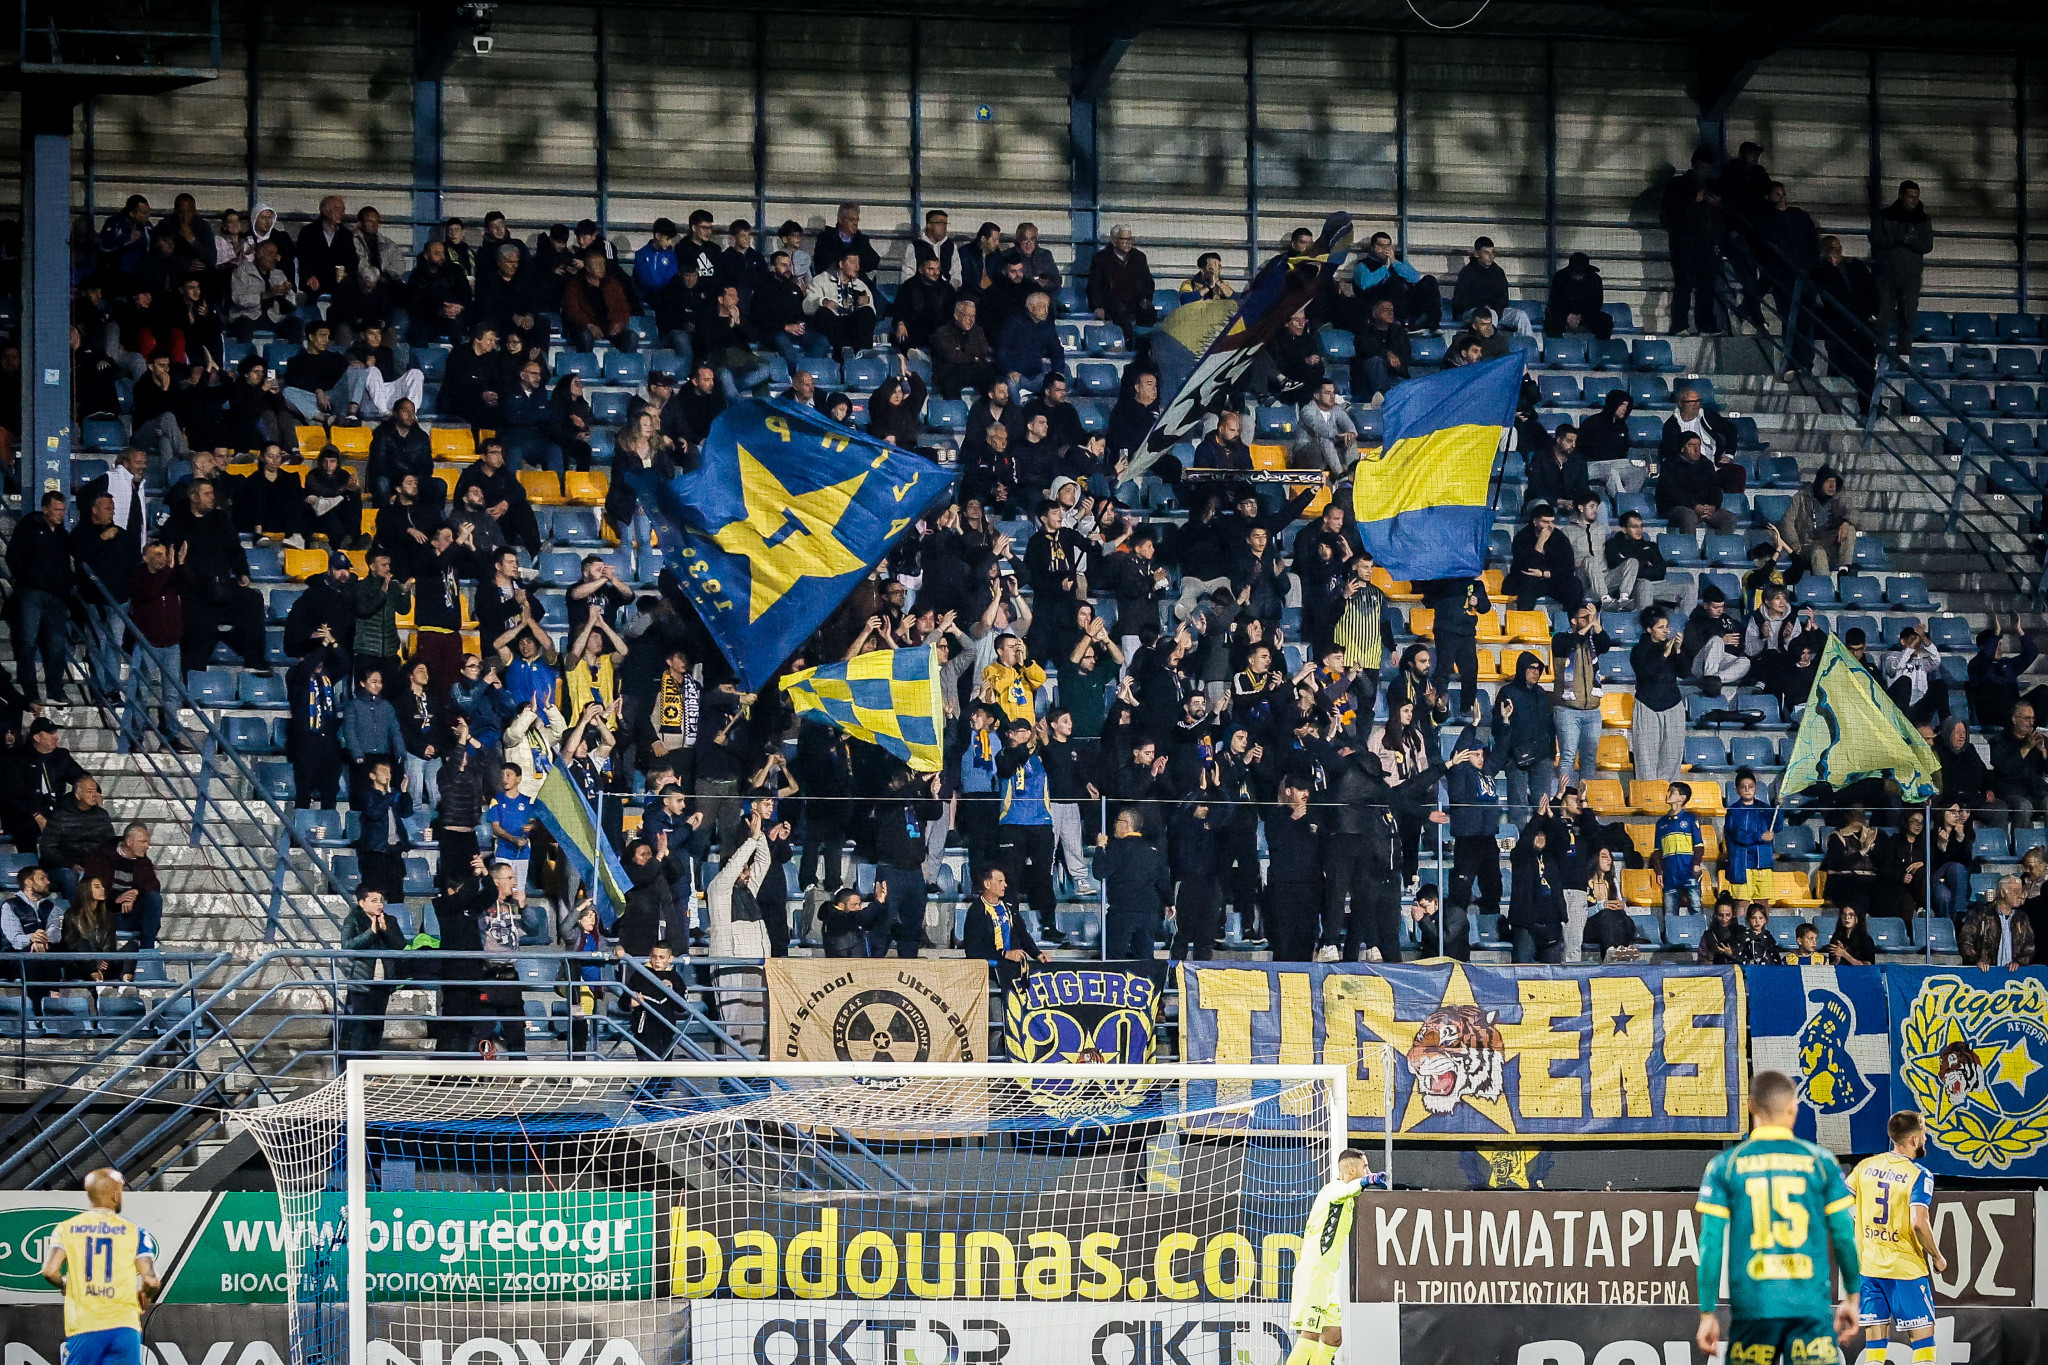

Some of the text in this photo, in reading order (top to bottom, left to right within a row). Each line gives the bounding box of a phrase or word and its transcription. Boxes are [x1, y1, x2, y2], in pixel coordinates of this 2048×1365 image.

[796, 971, 854, 1021] School
[897, 970, 950, 1014] Ultras
[1012, 970, 1156, 1010] TIGERS
[1926, 977, 2045, 1030] Tigers
[836, 997, 929, 1052] ΑΣΤΕΡΑΣ ΤΡΙΠΟΛΗΣ
[1197, 967, 1728, 1119] TIGERS
[1865, 1167, 1909, 1184] novibet
[1744, 1176, 1811, 1251] 15
[1872, 1181, 1890, 1225] 3
[69, 1222, 127, 1235] novibet
[222, 1207, 632, 1263] wwwbiogreco.gr
[1375, 1206, 1701, 1268] ΚΛΗΜΑΤΑΡΙΑ
[84, 1235, 114, 1284] 17
[347, 1271, 481, 1293] ΟΤΟΠΟΥΛΑ
[85, 1284, 115, 1299] ALHO
[1597, 1280, 1690, 1304] ΤΑΒΕΡΝΑ
